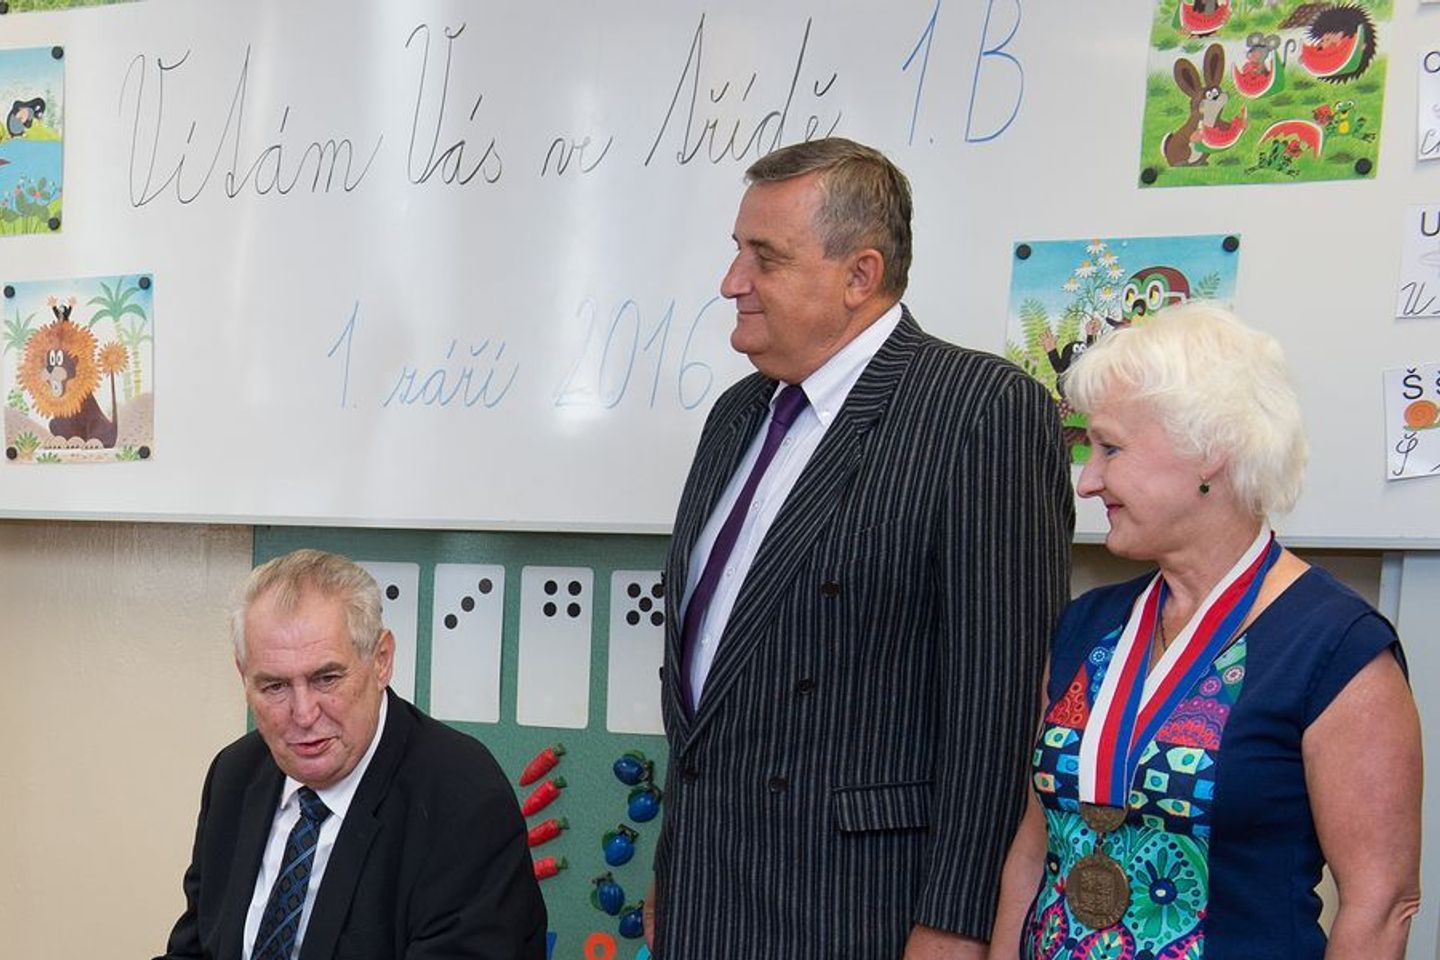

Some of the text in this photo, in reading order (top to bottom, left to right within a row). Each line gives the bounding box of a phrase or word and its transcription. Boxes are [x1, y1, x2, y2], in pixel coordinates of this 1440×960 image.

[119, 44, 384, 208] Vítám
[406, 22, 502, 186] Vás
[541, 135, 613, 177] ve
[902, 0, 942, 147] 1.
[965, 0, 1025, 143] B
[383, 340, 520, 410] září
[554, 296, 722, 411] 2016
[1402, 368, 1424, 400] Š
